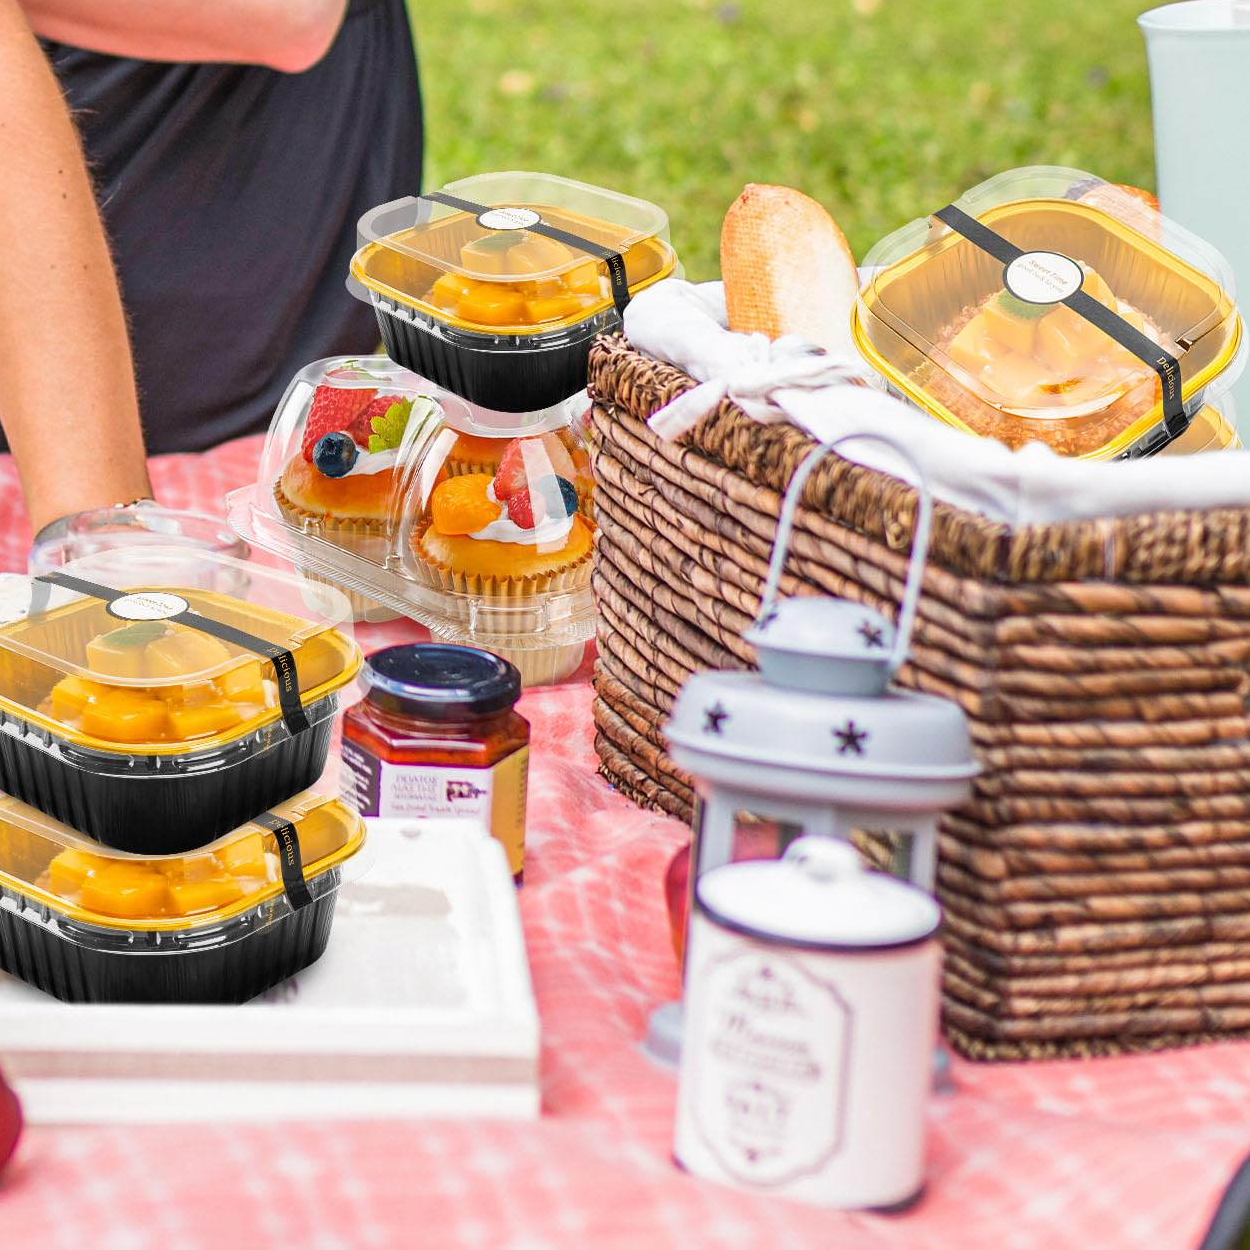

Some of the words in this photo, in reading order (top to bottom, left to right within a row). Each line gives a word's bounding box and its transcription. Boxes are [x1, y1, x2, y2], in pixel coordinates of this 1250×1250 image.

[1157, 356, 1175, 400] Delicious
[266, 648, 293, 693] Delicious
[269, 818, 295, 866] Delicious
